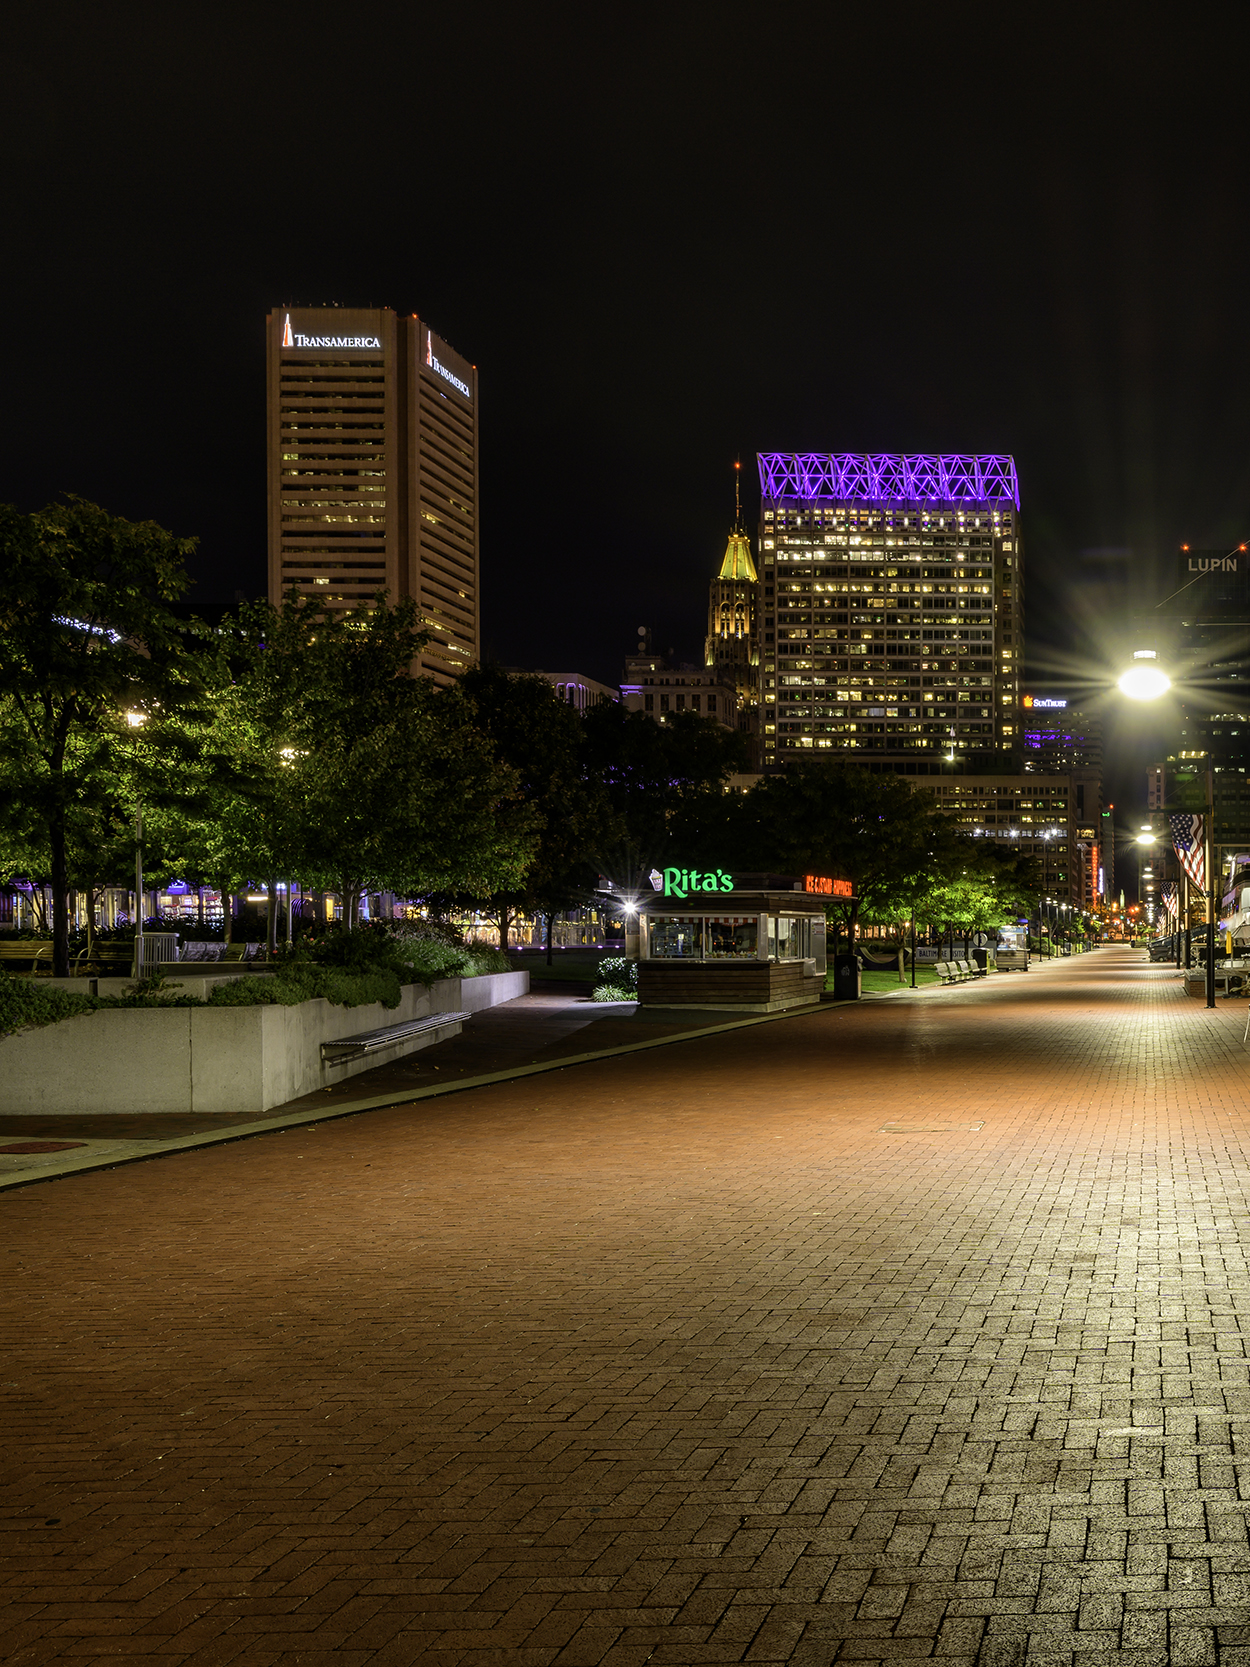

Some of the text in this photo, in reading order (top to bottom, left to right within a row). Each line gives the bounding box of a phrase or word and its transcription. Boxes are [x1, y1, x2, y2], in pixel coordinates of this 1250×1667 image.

[294, 335, 381, 348] TRANSAMERICA
[432, 356, 470, 398] TRANSAMERICA
[1188, 558, 1238, 572] LUPIN
[663, 867, 734, 898] Rita's
[918, 950, 947, 958] BALTIMRE
